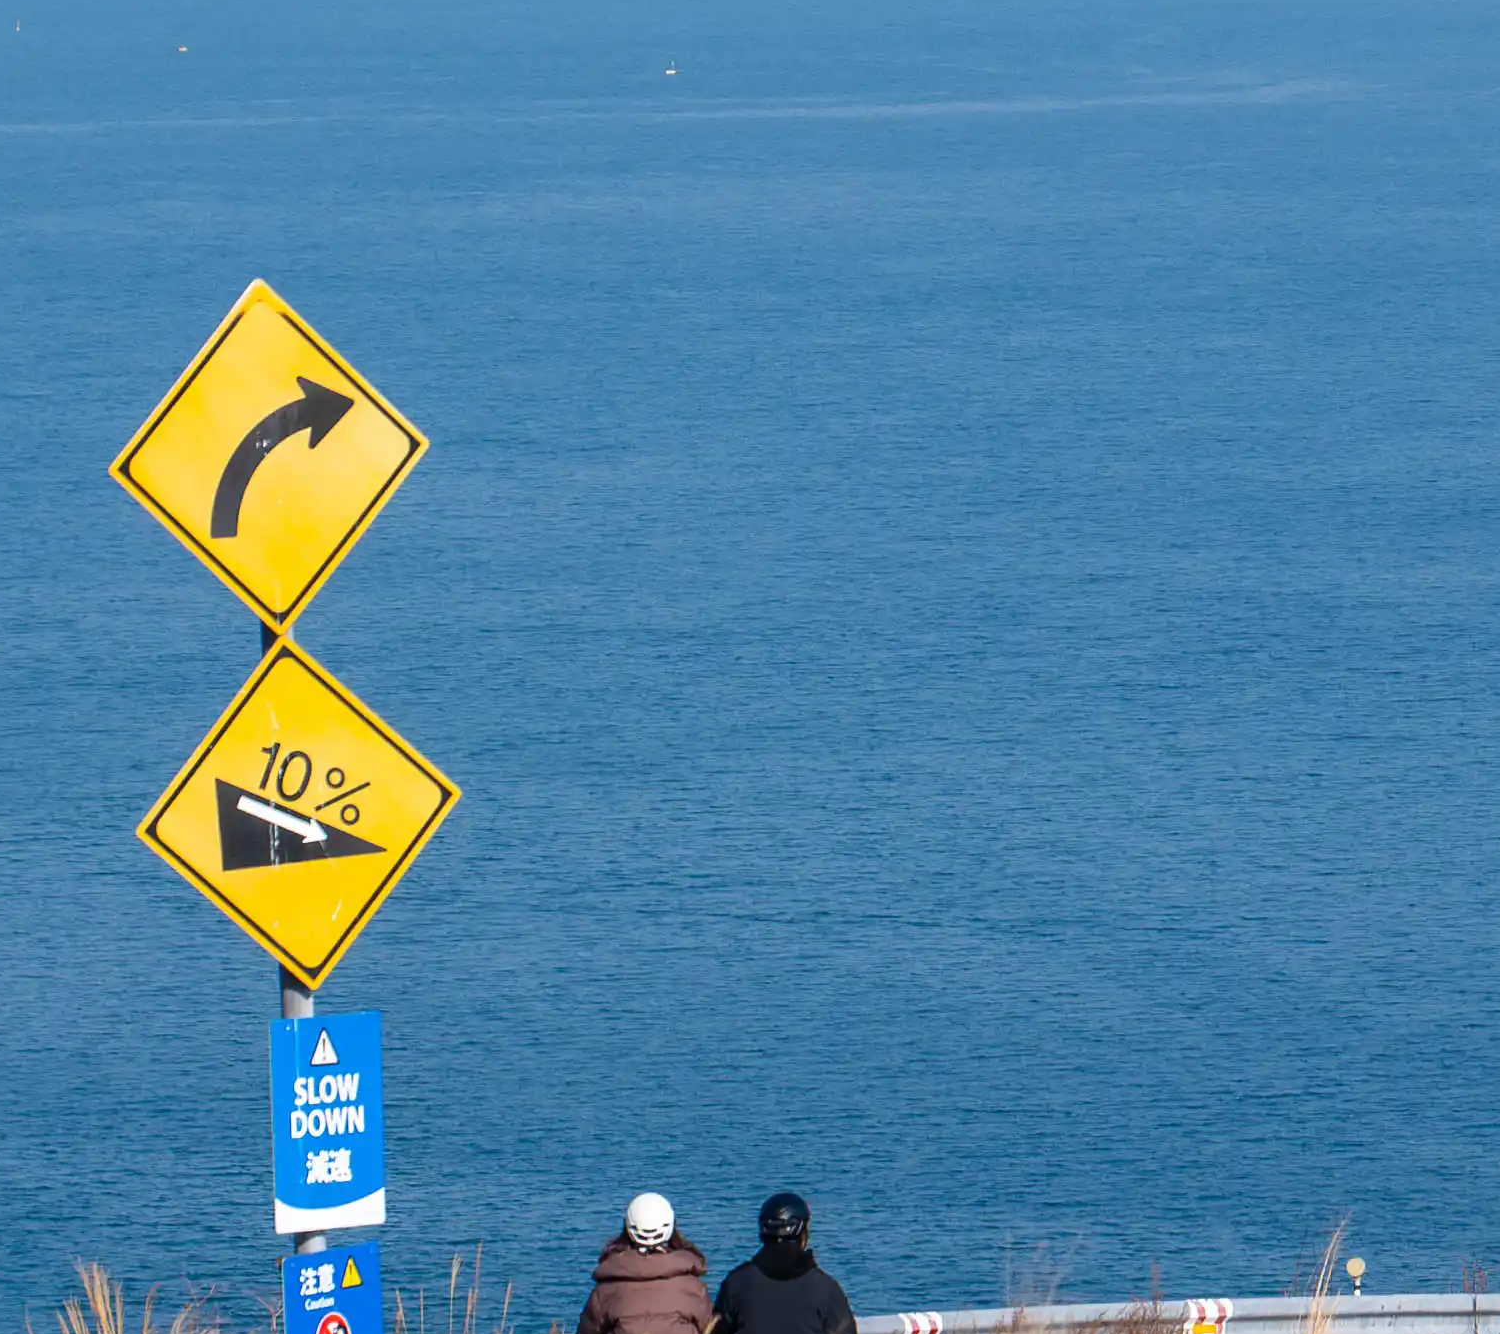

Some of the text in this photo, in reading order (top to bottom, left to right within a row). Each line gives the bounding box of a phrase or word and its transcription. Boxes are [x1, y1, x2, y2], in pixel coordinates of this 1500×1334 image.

[259, 742, 371, 825] 10%
[293, 1072, 360, 1106] SLOW
[290, 1104, 365, 1139] DOWN
[306, 1148, 353, 1185] 減速
[299, 1263, 336, 1296] 注意
[304, 1297, 335, 1312] Caution
